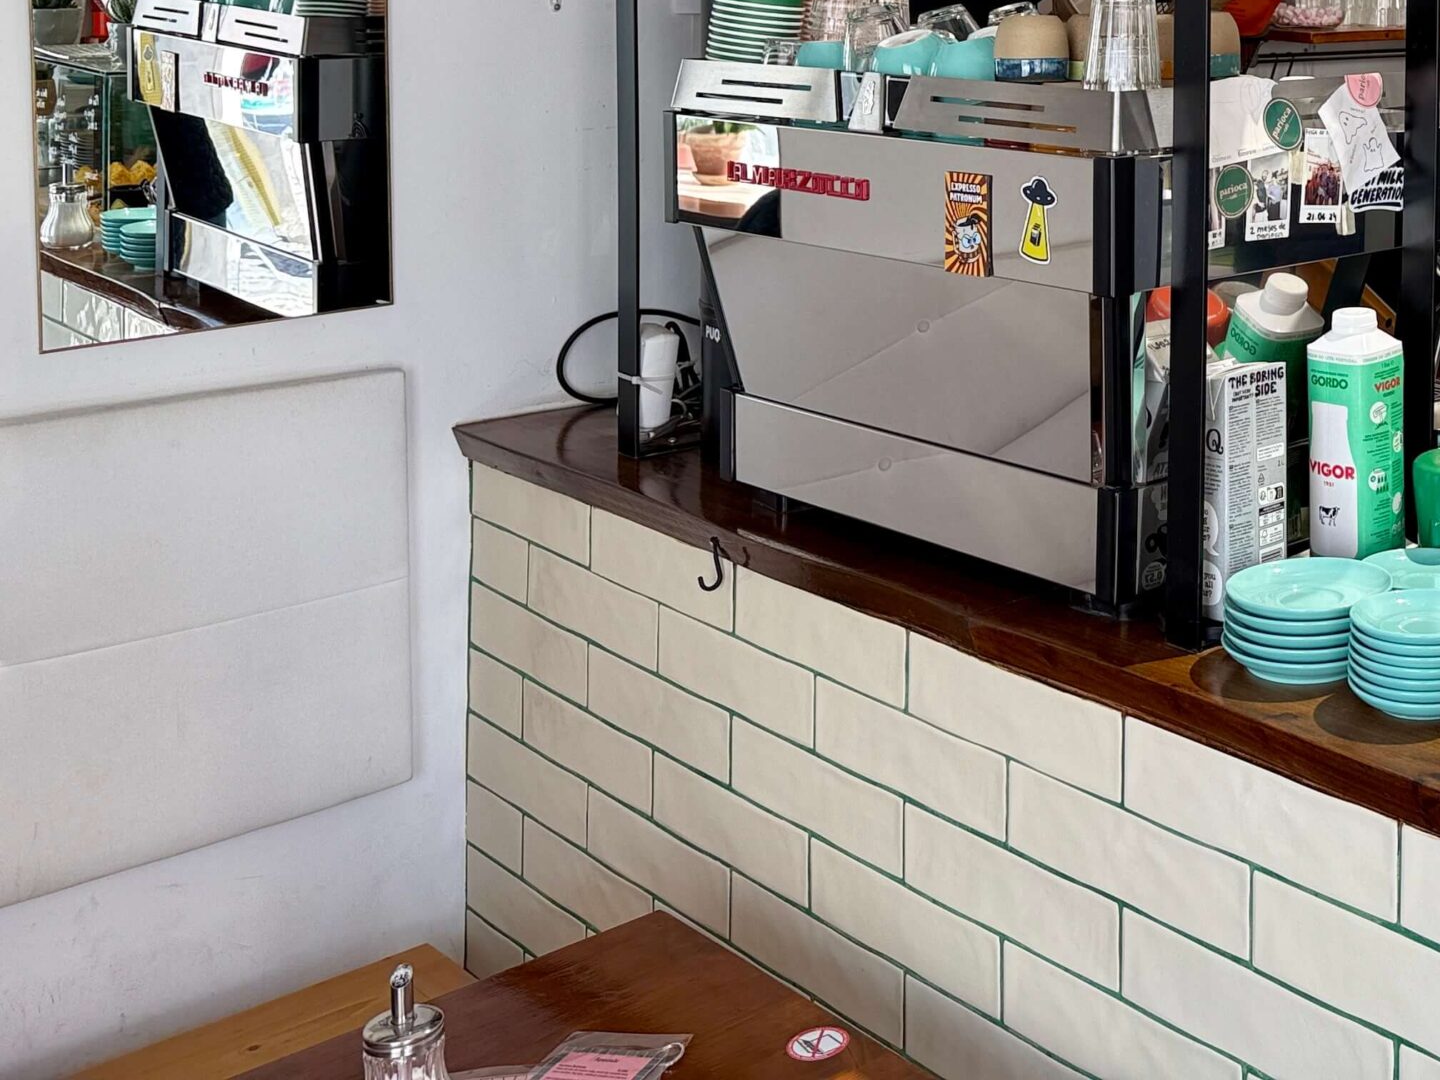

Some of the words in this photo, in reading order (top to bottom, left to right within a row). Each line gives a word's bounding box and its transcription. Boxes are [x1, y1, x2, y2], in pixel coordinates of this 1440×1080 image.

[1272, 107, 1292, 139] parioca
[1377, 168, 1404, 187] MILK
[1219, 182, 1248, 200] parioca
[1351, 186, 1404, 205] GENERATIO
[1228, 374, 1248, 390] THE
[1249, 366, 1285, 385] BORING
[1311, 374, 1349, 390] GORDO
[1374, 376, 1401, 393] VIGOR
[1254, 381, 1277, 397] SIDE
[1309, 458, 1355, 481] VIGOR
